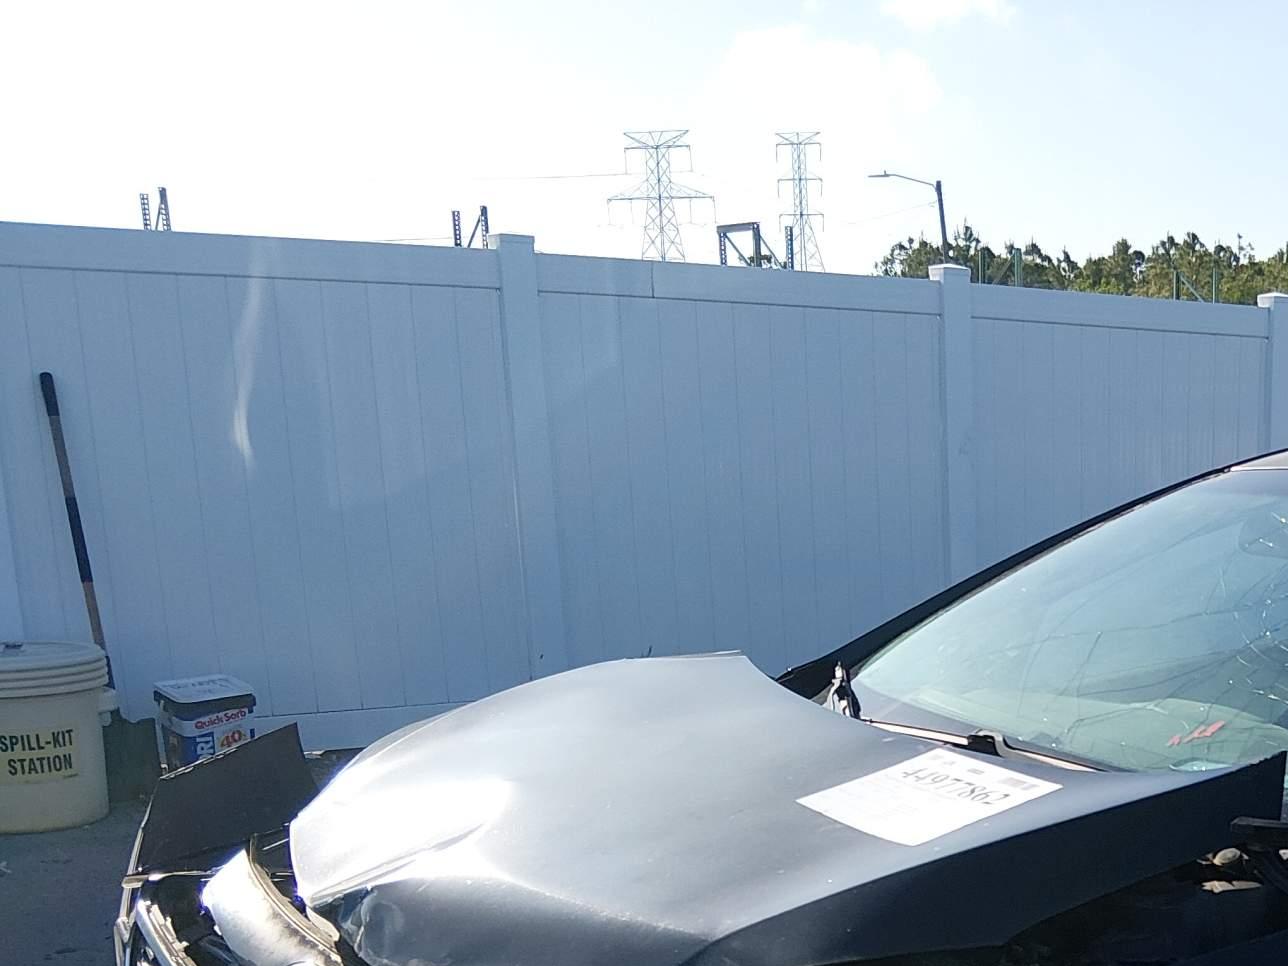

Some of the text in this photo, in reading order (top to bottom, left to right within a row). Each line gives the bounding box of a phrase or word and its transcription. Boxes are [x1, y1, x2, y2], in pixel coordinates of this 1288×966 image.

[194, 708, 247, 730] Quick Sorb
[0, 729, 74, 752] SPILL-KIT
[8, 753, 73, 776] STATION
[901, 768, 1011, 804] 44977862
